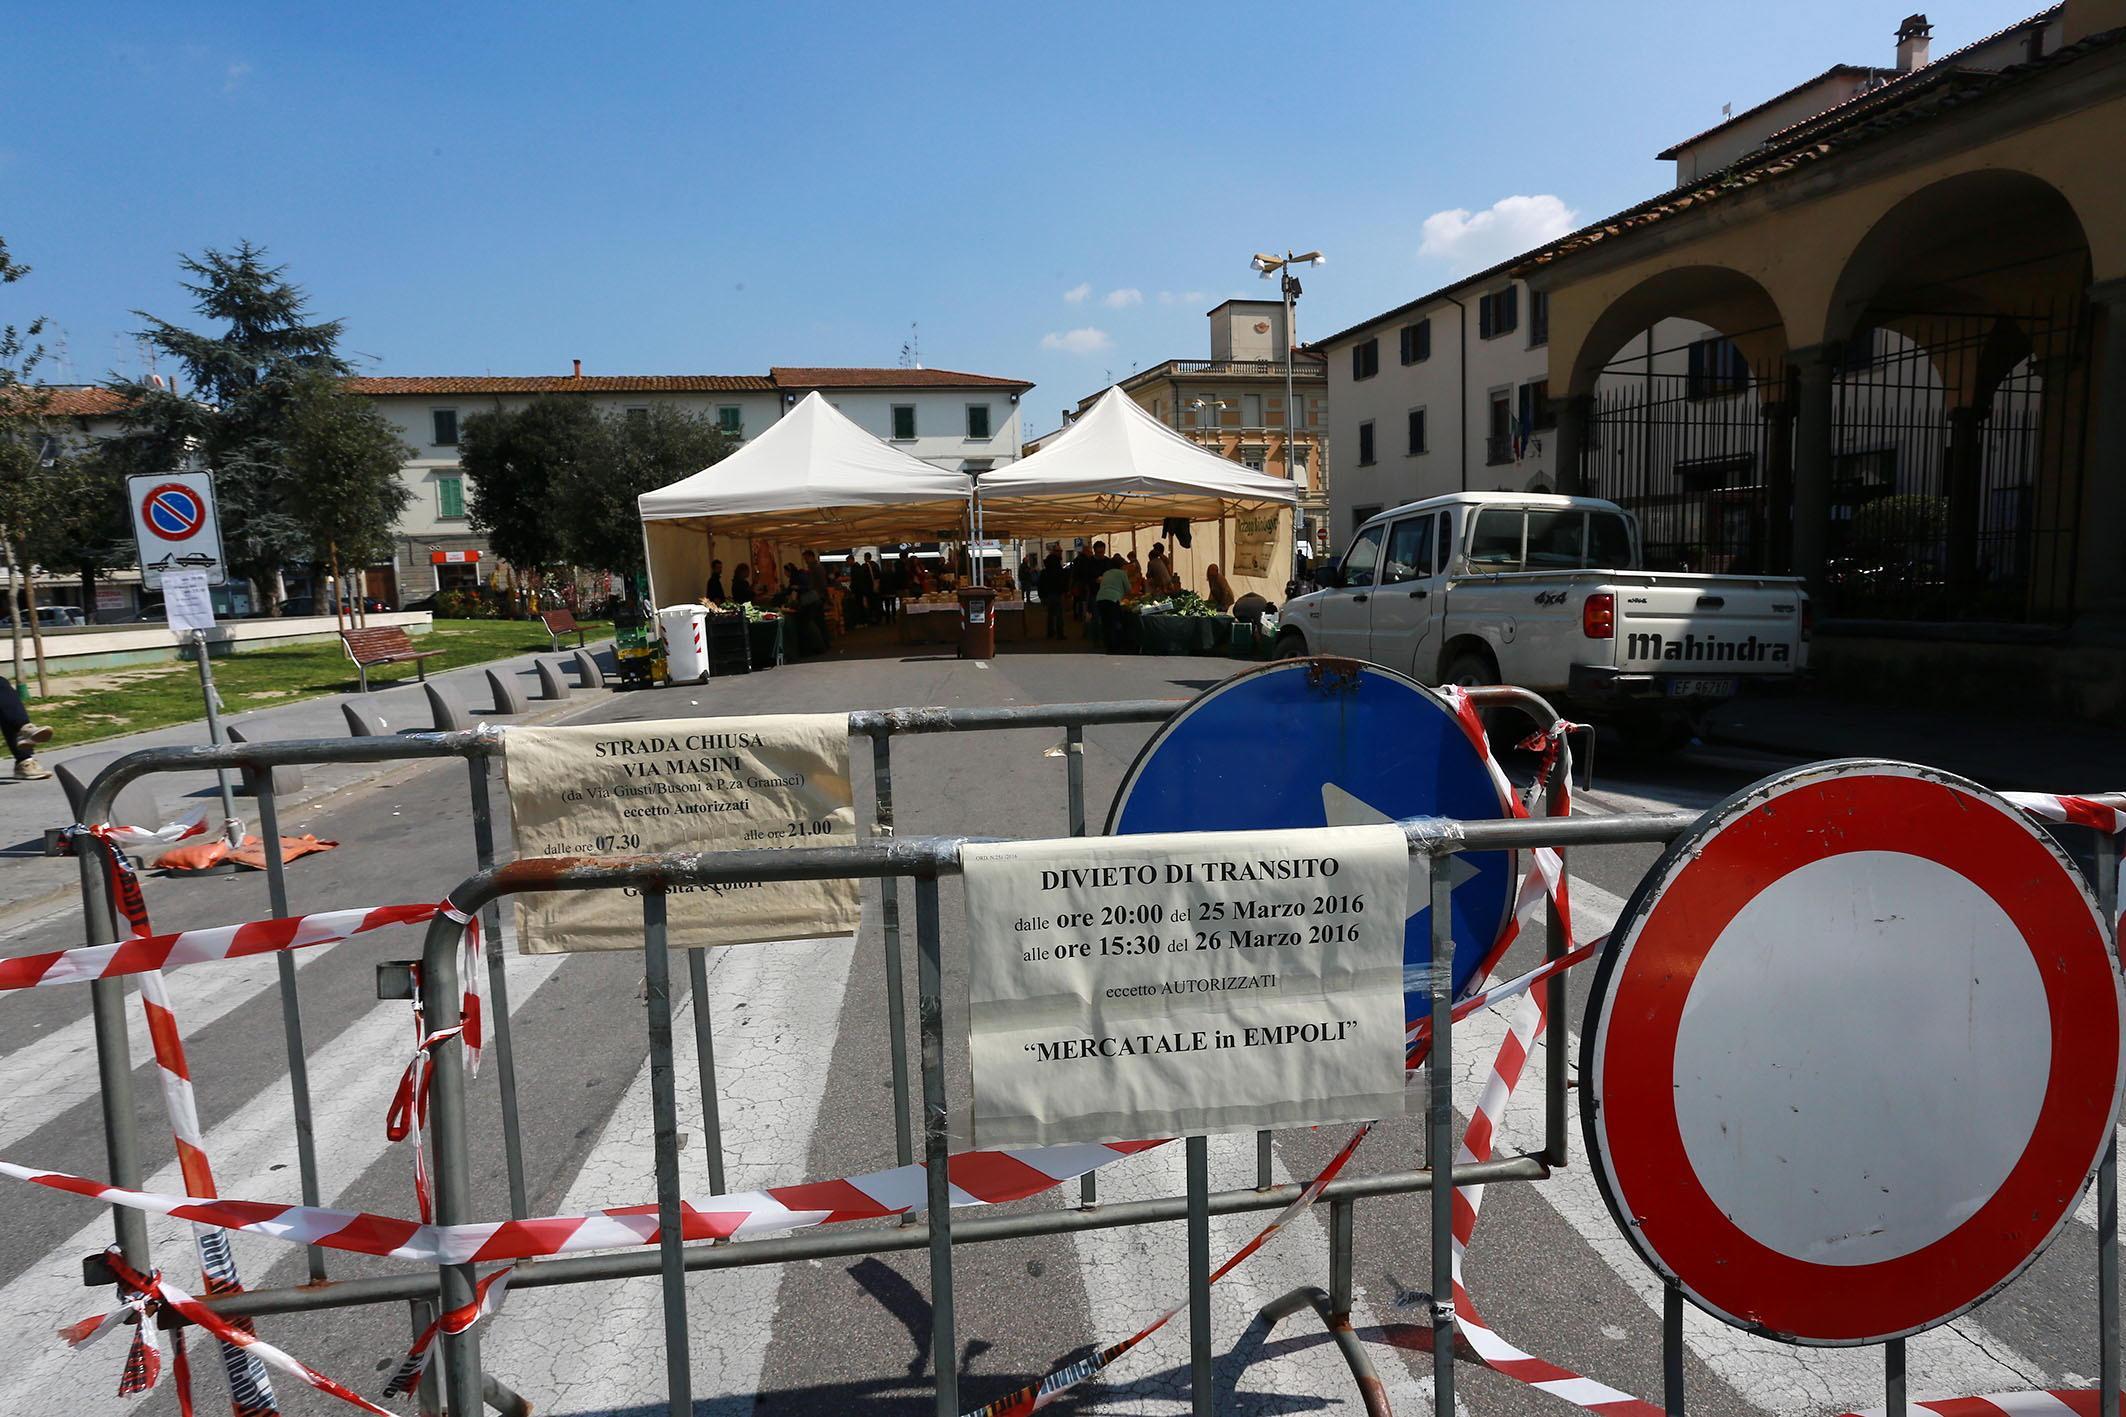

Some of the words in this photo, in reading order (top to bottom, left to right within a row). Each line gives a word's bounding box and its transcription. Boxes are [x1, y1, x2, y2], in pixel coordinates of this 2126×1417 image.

[1534, 591, 1567, 607] 4x4
[1627, 633, 1791, 661] mahindra
[595, 737, 681, 758] STRADA
[686, 732, 764, 751] CHIUSA
[622, 762, 661, 779] VIA
[667, 756, 740, 775] MASINI
[561, 790, 582, 802] (da
[587, 786, 610, 799] Via
[613, 780, 702, 798] Giusti/Busoni
[705, 782, 713, 791] a
[716, 777, 744, 791] P.za
[747, 773, 805, 789] Gramsci)
[624, 804, 670, 818] eccetto
[674, 798, 750, 814] Autorizzati
[744, 829, 764, 840] alle
[767, 830, 785, 839] ore
[787, 820, 832, 837] 21.00
[544, 843, 571, 855] dalle
[574, 842, 593, 853] ore
[595, 834, 640, 851] 07.30
[1041, 865, 1157, 891] DIVIETO
[1164, 864, 1194, 883] DI
[1201, 857, 1339, 883] TRANSITO
[1014, 916, 1050, 932] dalle
[1056, 911, 1094, 929] ore
[1101, 903, 1163, 926] 20:00
[1170, 908, 1191, 923] del
[1199, 902, 1226, 921] 25
[1232, 896, 1306, 920] Marzo
[1312, 893, 1365, 915] 2016
[1023, 947, 1050, 962] alle
[1054, 941, 1091, 959] ore
[1100, 934, 1161, 957] 15:30
[1167, 938, 1188, 953] del
[1195, 931, 1222, 951] 26
[1229, 926, 1302, 950] Marzo
[1309, 923, 1360, 946] 2016
[1106, 984, 1157, 998] eccetto
[1162, 973, 1277, 995] AUTORIZZATI
[1024, 1030, 1208, 1063] “MERCATALE
[1214, 1030, 1237, 1049] in
[1243, 1020, 1359, 1048] EMPOLI”
